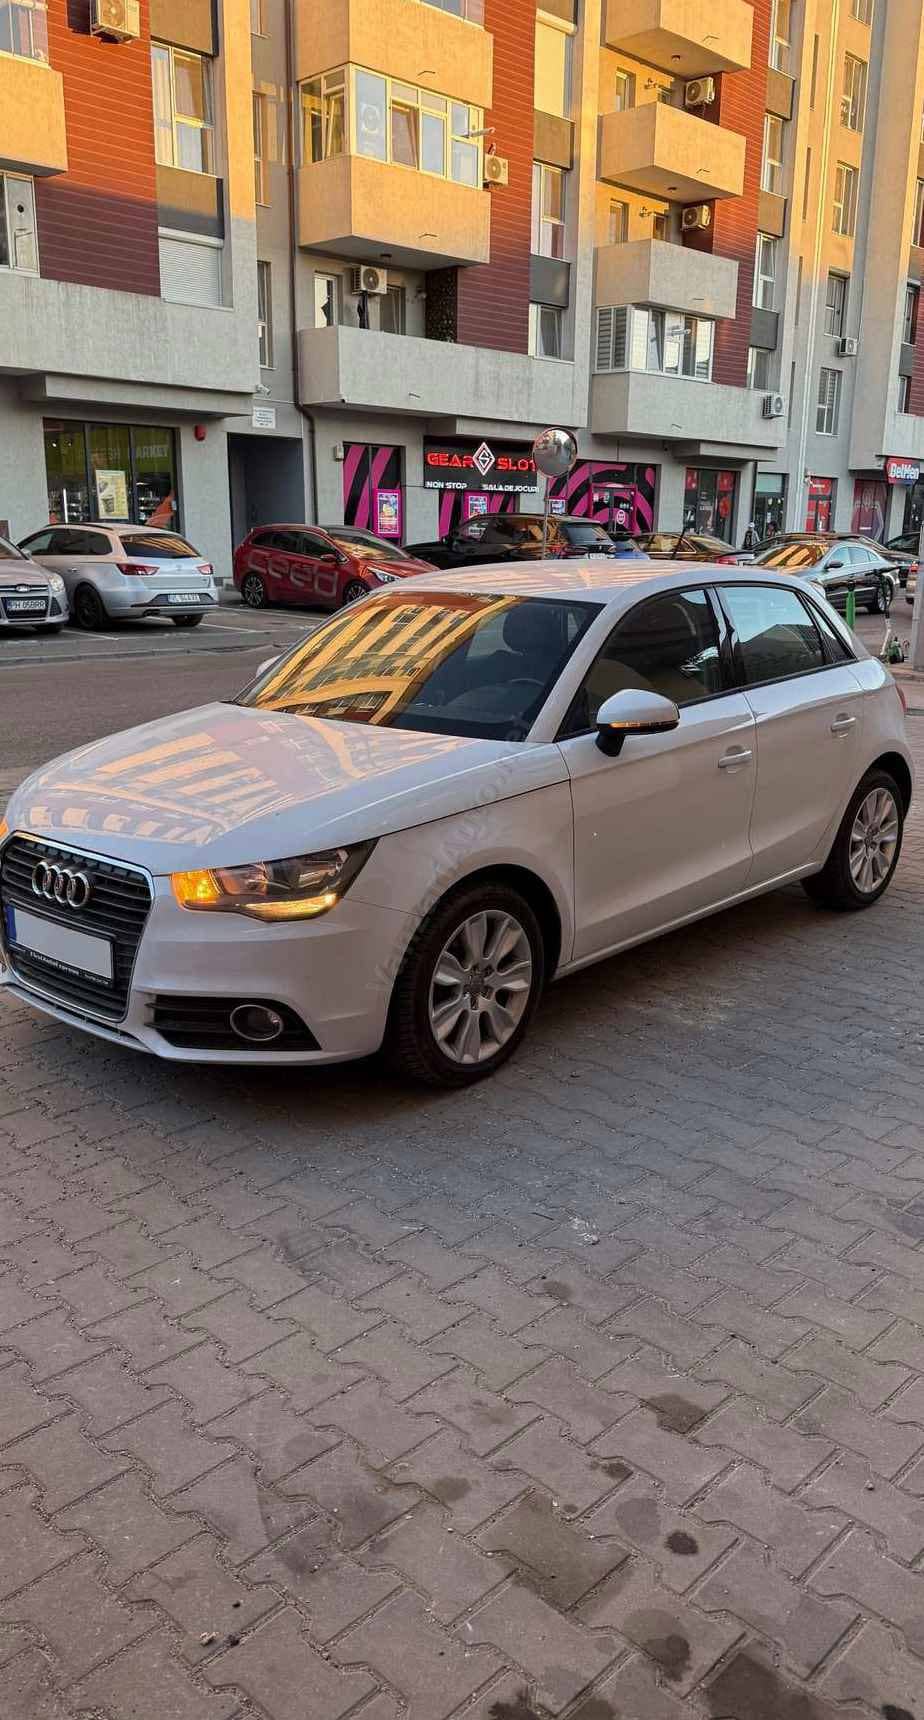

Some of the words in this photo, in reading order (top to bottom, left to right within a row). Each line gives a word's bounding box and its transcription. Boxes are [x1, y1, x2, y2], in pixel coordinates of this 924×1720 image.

[427, 452, 474, 468] GEAR
[426, 481, 444, 489] NON
[514, 485, 540, 493] JOCURI
